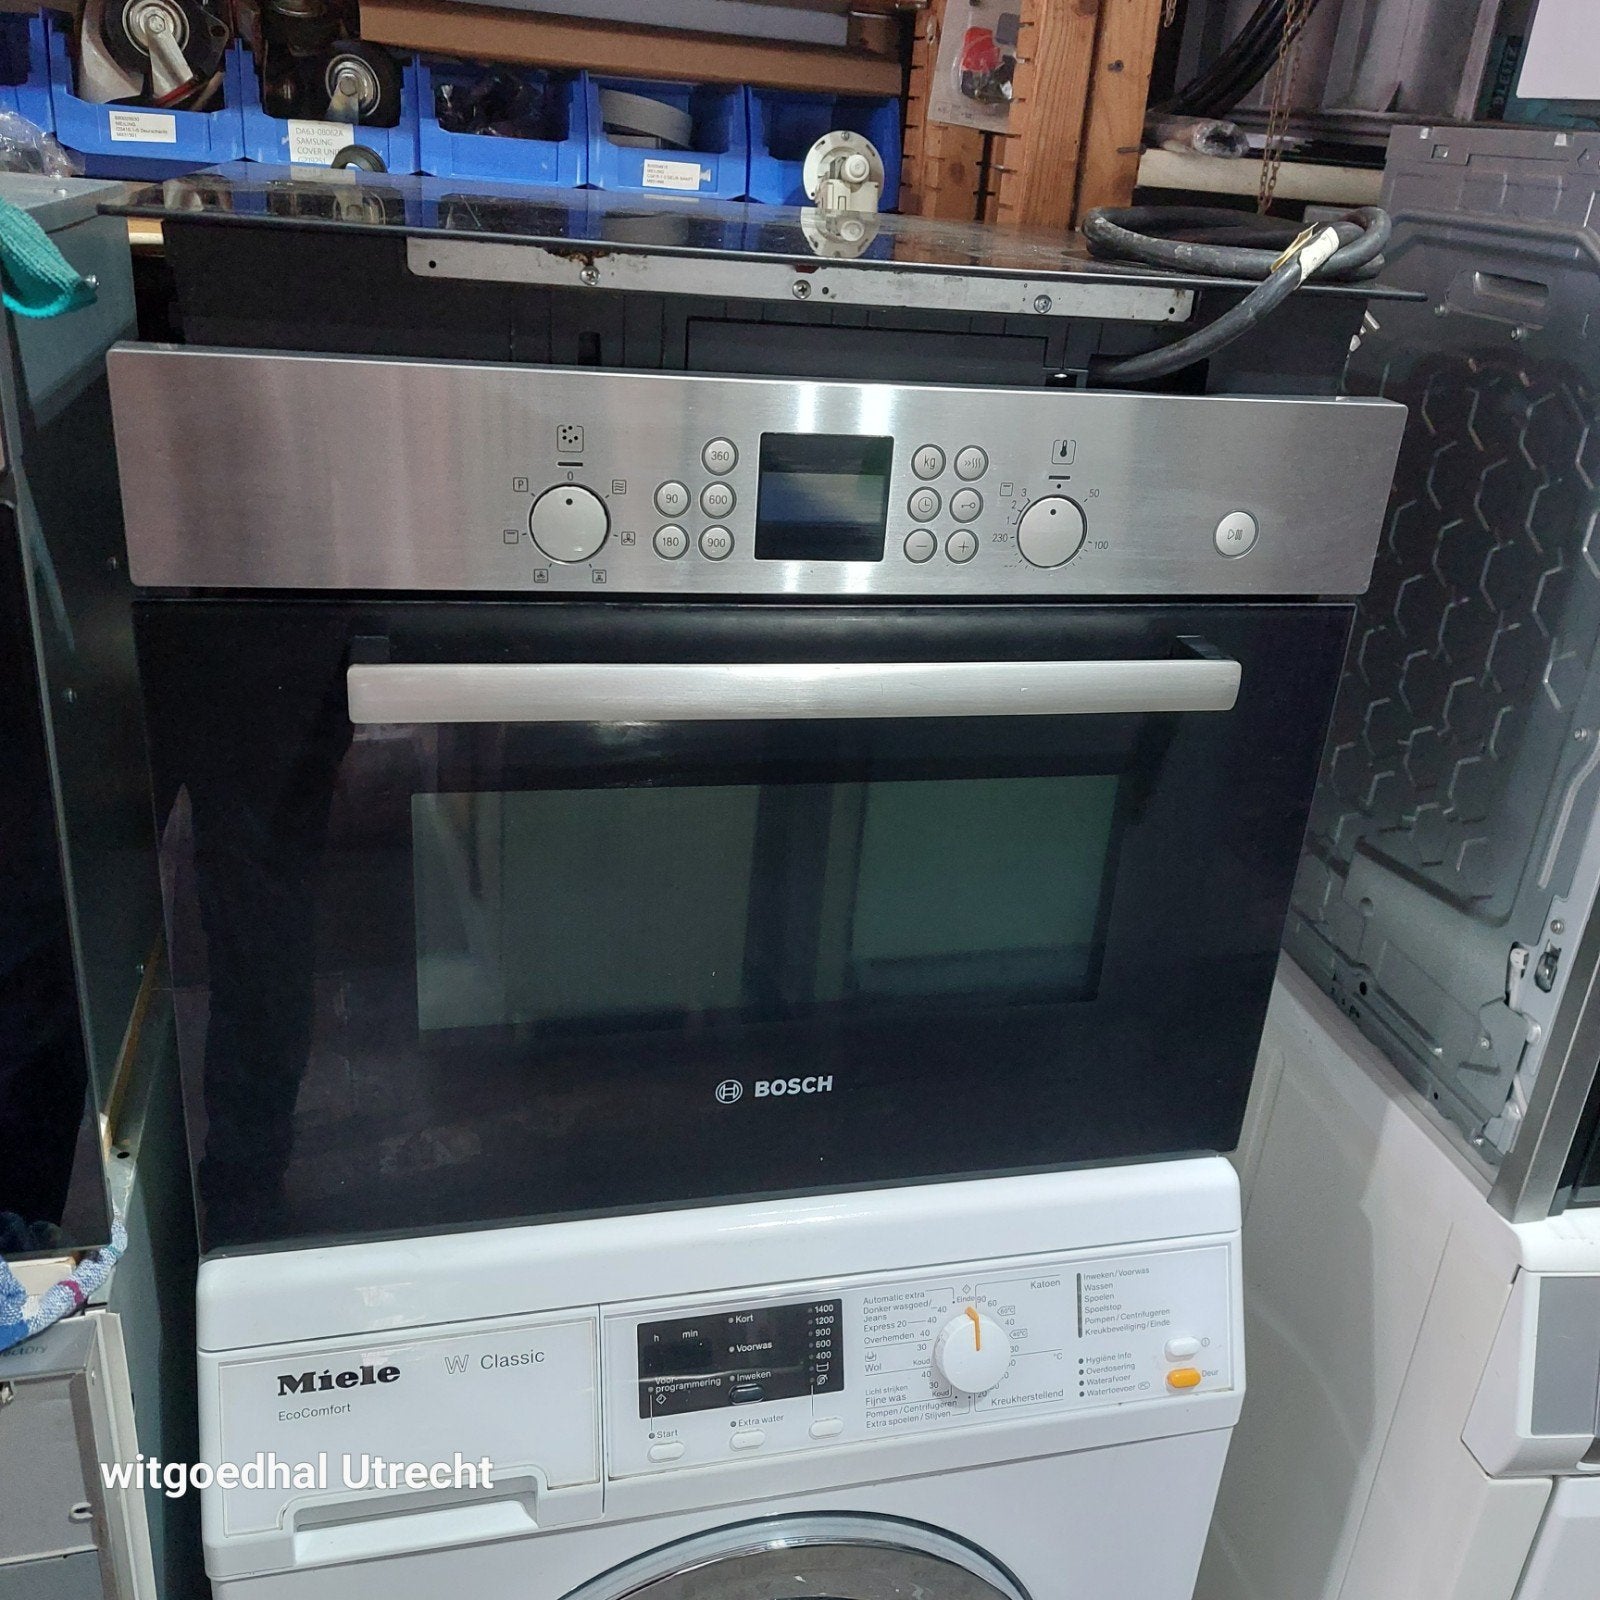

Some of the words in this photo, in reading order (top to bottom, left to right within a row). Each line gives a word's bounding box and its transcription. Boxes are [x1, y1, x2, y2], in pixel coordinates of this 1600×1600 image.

[296, 136, 333, 147] SAMSUNG
[297, 146, 323, 156] COVER
[710, 450, 730, 462] 360
[923, 454, 936, 470] kg
[567, 471, 574, 481] 0
[1021, 488, 1027, 497] 3
[1089, 488, 1100, 498] 50
[665, 493, 679, 505] 90
[708, 494, 728, 506] 600
[1011, 500, 1017, 510] 2
[662, 536, 679, 548] 180
[707, 537, 726, 549] 900
[992, 533, 1009, 543] 230
[1094, 540, 1109, 550] 100
[754, 1075, 834, 1098] BOSCH
[1030, 1279, 1061, 1290] Katoen
[1083, 1282, 1114, 1292] Wassen
[862, 1293, 904, 1305] Automatic
[904, 1290, 925, 1301] extra
[1084, 1293, 1115, 1304] Spoelen
[814, 1303, 834, 1314] 1400
[987, 1299, 998, 1308] 60
[1084, 1303, 1122, 1315] Spoelstop
[863, 1304, 892, 1315] Donker
[937, 1305, 947, 1314] 40
[735, 1314, 754, 1324] Kort
[815, 1315, 834, 1326] 1200
[863, 1314, 888, 1324] Jeans
[927, 1316, 938, 1325] 40
[1004, 1318, 1015, 1327] 40
[863, 1321, 896, 1333] Express
[896, 1320, 908, 1329] 20
[653, 1333, 660, 1343] h
[682, 1328, 699, 1340] min
[815, 1327, 831, 1338] 900
[863, 1331, 915, 1345] Overhemden
[919, 1329, 931, 1338] 40
[736, 1341, 773, 1353] Voorwas
[815, 1339, 832, 1349] 600
[917, 1343, 927, 1352] 30
[1009, 1345, 1020, 1354] 30
[816, 1350, 832, 1360] 400
[1053, 1352, 1063, 1361] °C
[444, 1353, 470, 1375] W
[480, 1348, 545, 1370] Classic
[864, 1363, 882, 1373] Wol
[912, 1358, 931, 1367] Koud
[921, 1370, 932, 1379] 40
[1086, 1363, 1136, 1375] Overdosering
[1201, 1368, 1219, 1379] Deur
[277, 1365, 401, 1397] Miele
[736, 1370, 772, 1382] Inweken
[1086, 1374, 1131, 1386] Waterafvoer
[655, 1378, 722, 1394] programmering
[865, 1388, 882, 1397] Licht
[882, 1385, 909, 1396] strijken
[929, 1381, 939, 1390] 30
[1086, 1385, 1136, 1397] Watertoevoer
[932, 1389, 950, 1398] Koud
[991, 1388, 1064, 1407] Kreukherstellend
[865, 1396, 887, 1407] Fijne
[888, 1394, 908, 1403] was
[278, 1402, 352, 1422] EcoComfort
[738, 1417, 761, 1428] Extra
[761, 1414, 785, 1425] water
[866, 1420, 888, 1429] Extra
[656, 1428, 679, 1440] Start
